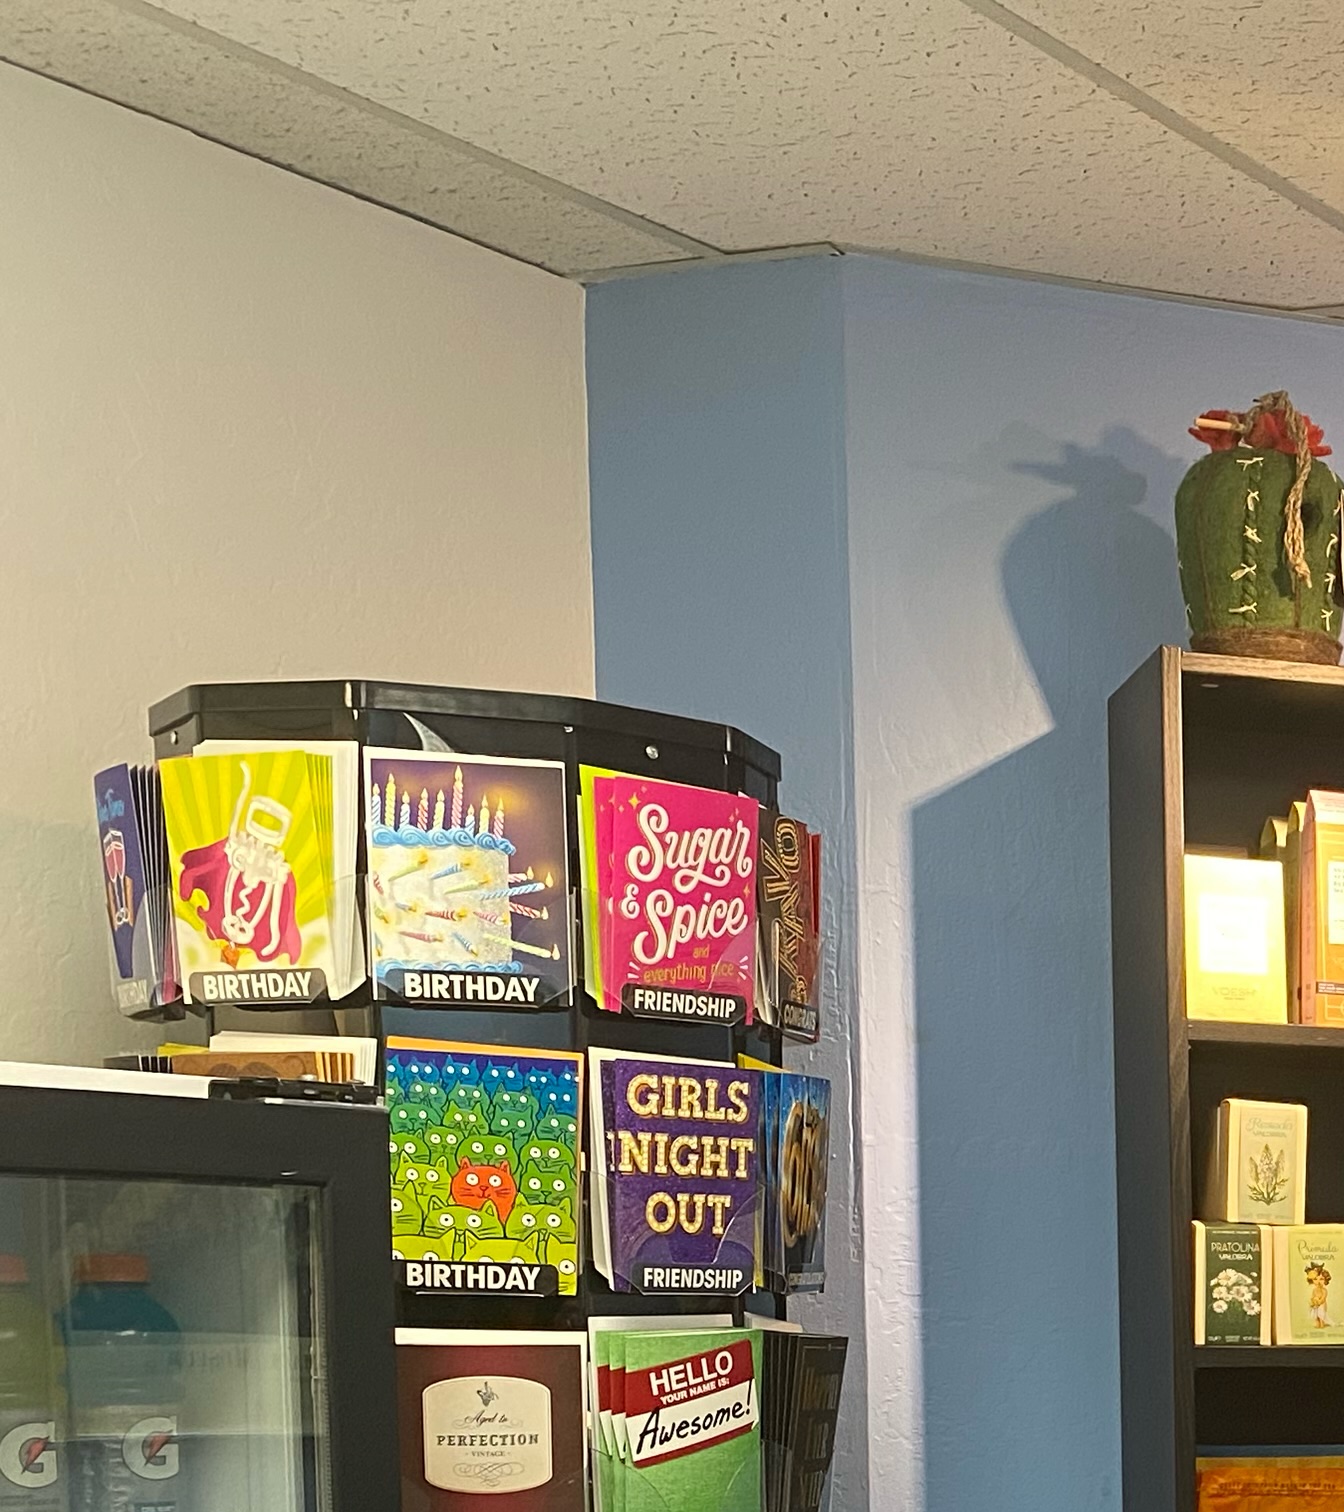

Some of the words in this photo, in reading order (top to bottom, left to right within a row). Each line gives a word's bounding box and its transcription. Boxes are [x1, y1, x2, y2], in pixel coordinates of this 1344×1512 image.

[630, 804, 754, 887] Sugar
[621, 879, 639, 918] &
[633, 887, 748, 965] Spice
[203, 971, 312, 1000] BIRTHDAY
[404, 973, 540, 1002] BIRTHDAY
[633, 988, 736, 1017] FRIENDSHIP
[627, 1073, 751, 1123] GIRLS
[621, 1133, 755, 1179] NIGHT
[645, 1191, 731, 1236] OUT
[1211, 1241, 1260, 1252] PRATOLINA
[407, 1263, 541, 1290] BIRTHDAY
[642, 1266, 743, 1289] FRIENDSHIP
[649, 1351, 733, 1394] HELLO
[660, 1389, 688, 1405] YOUR
[689, 1382, 715, 1398] NAME
[716, 1377, 730, 1389] IS:
[636, 1378, 754, 1455] Awesome!
[435, 1432, 539, 1448] PERFECTION
